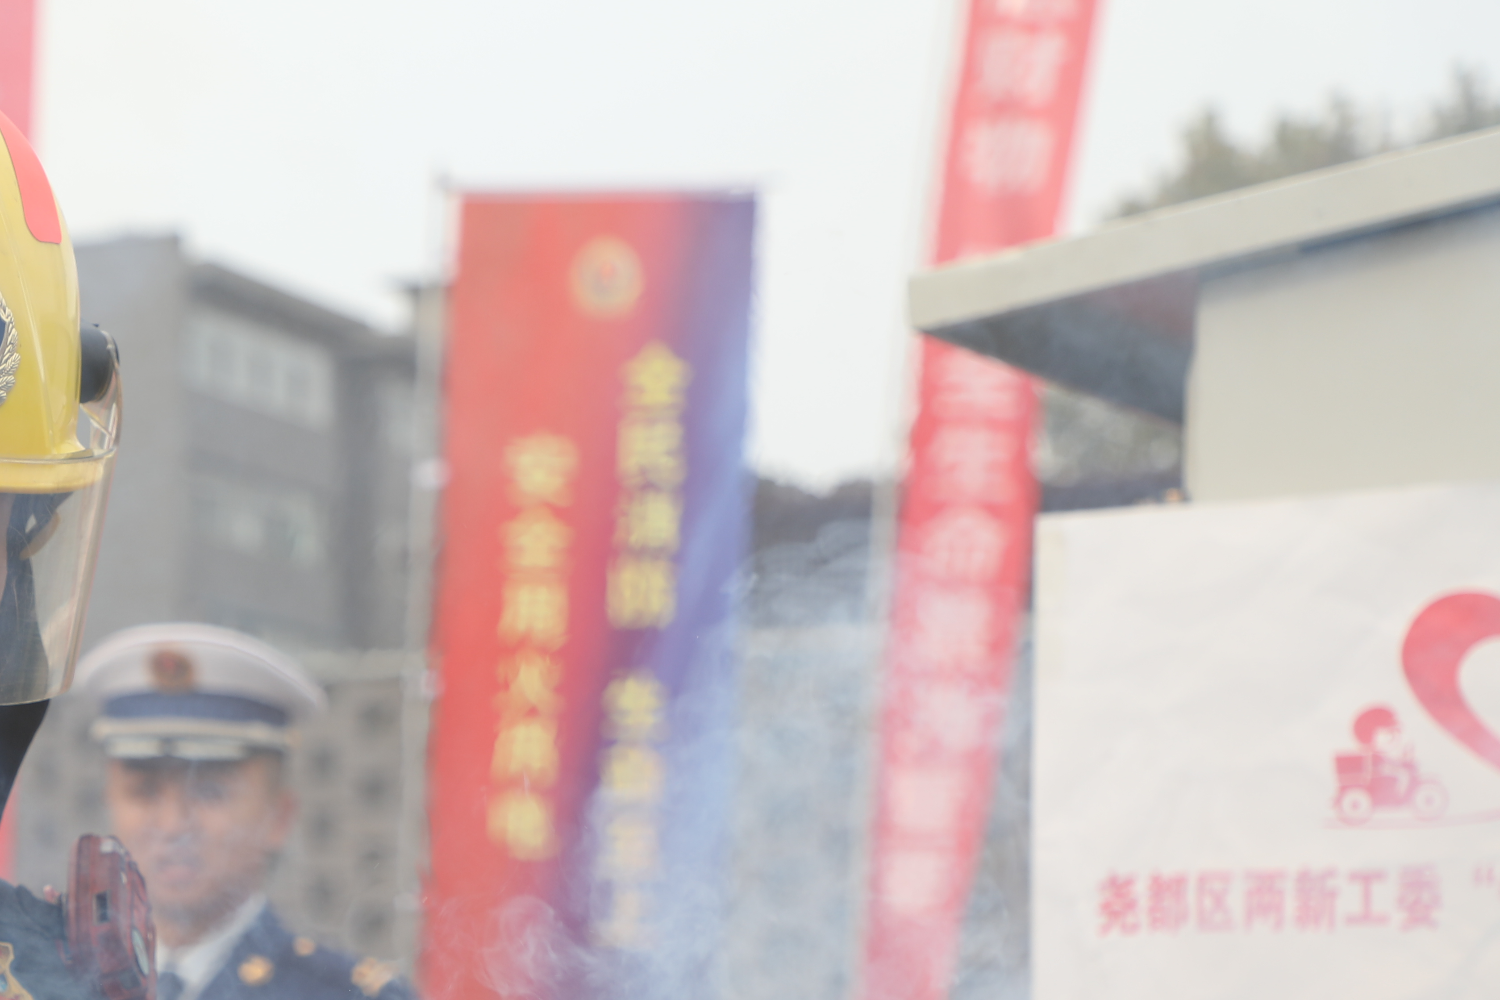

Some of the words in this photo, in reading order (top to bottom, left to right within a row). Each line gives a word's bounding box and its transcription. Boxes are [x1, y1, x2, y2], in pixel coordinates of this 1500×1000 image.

[1098, 864, 1442, 936] 尧都区两新工委
